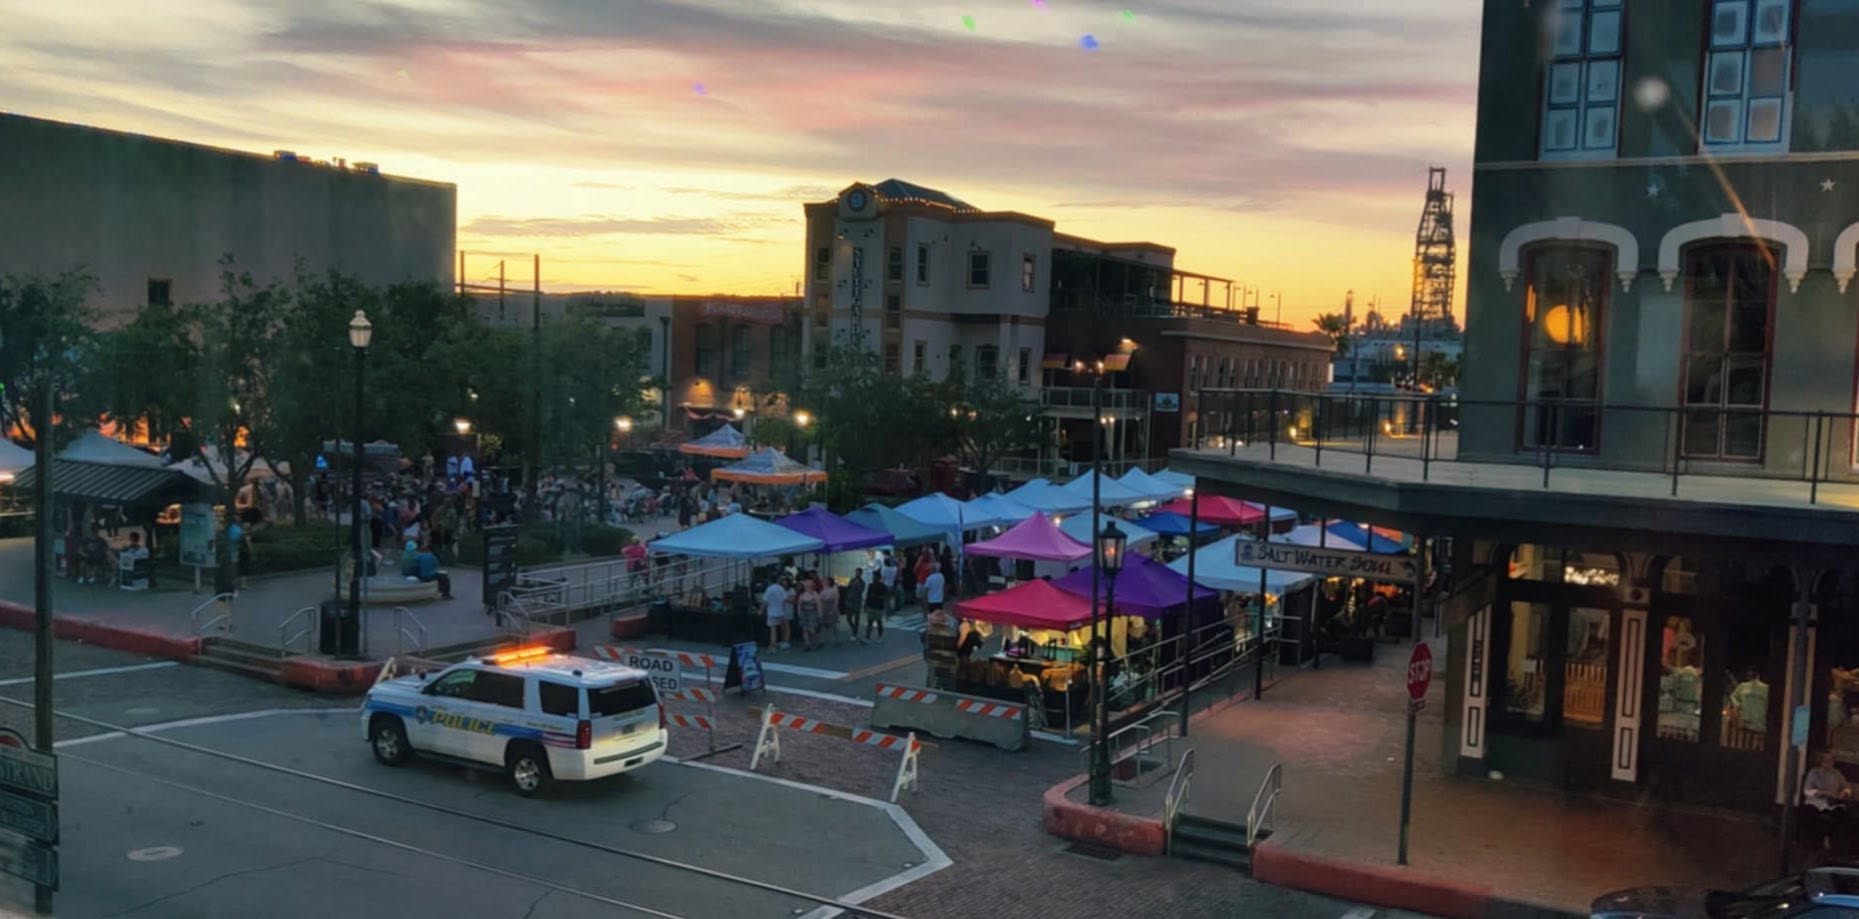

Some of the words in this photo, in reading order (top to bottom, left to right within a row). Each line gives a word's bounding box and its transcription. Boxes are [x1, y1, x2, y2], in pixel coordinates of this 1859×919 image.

[1257, 543, 1291, 563] SALT
[1294, 549, 1348, 569] WATER
[629, 655, 673, 672] ROAD
[1408, 652, 1430, 684] STOP
[431, 709, 496, 735] POLICE
